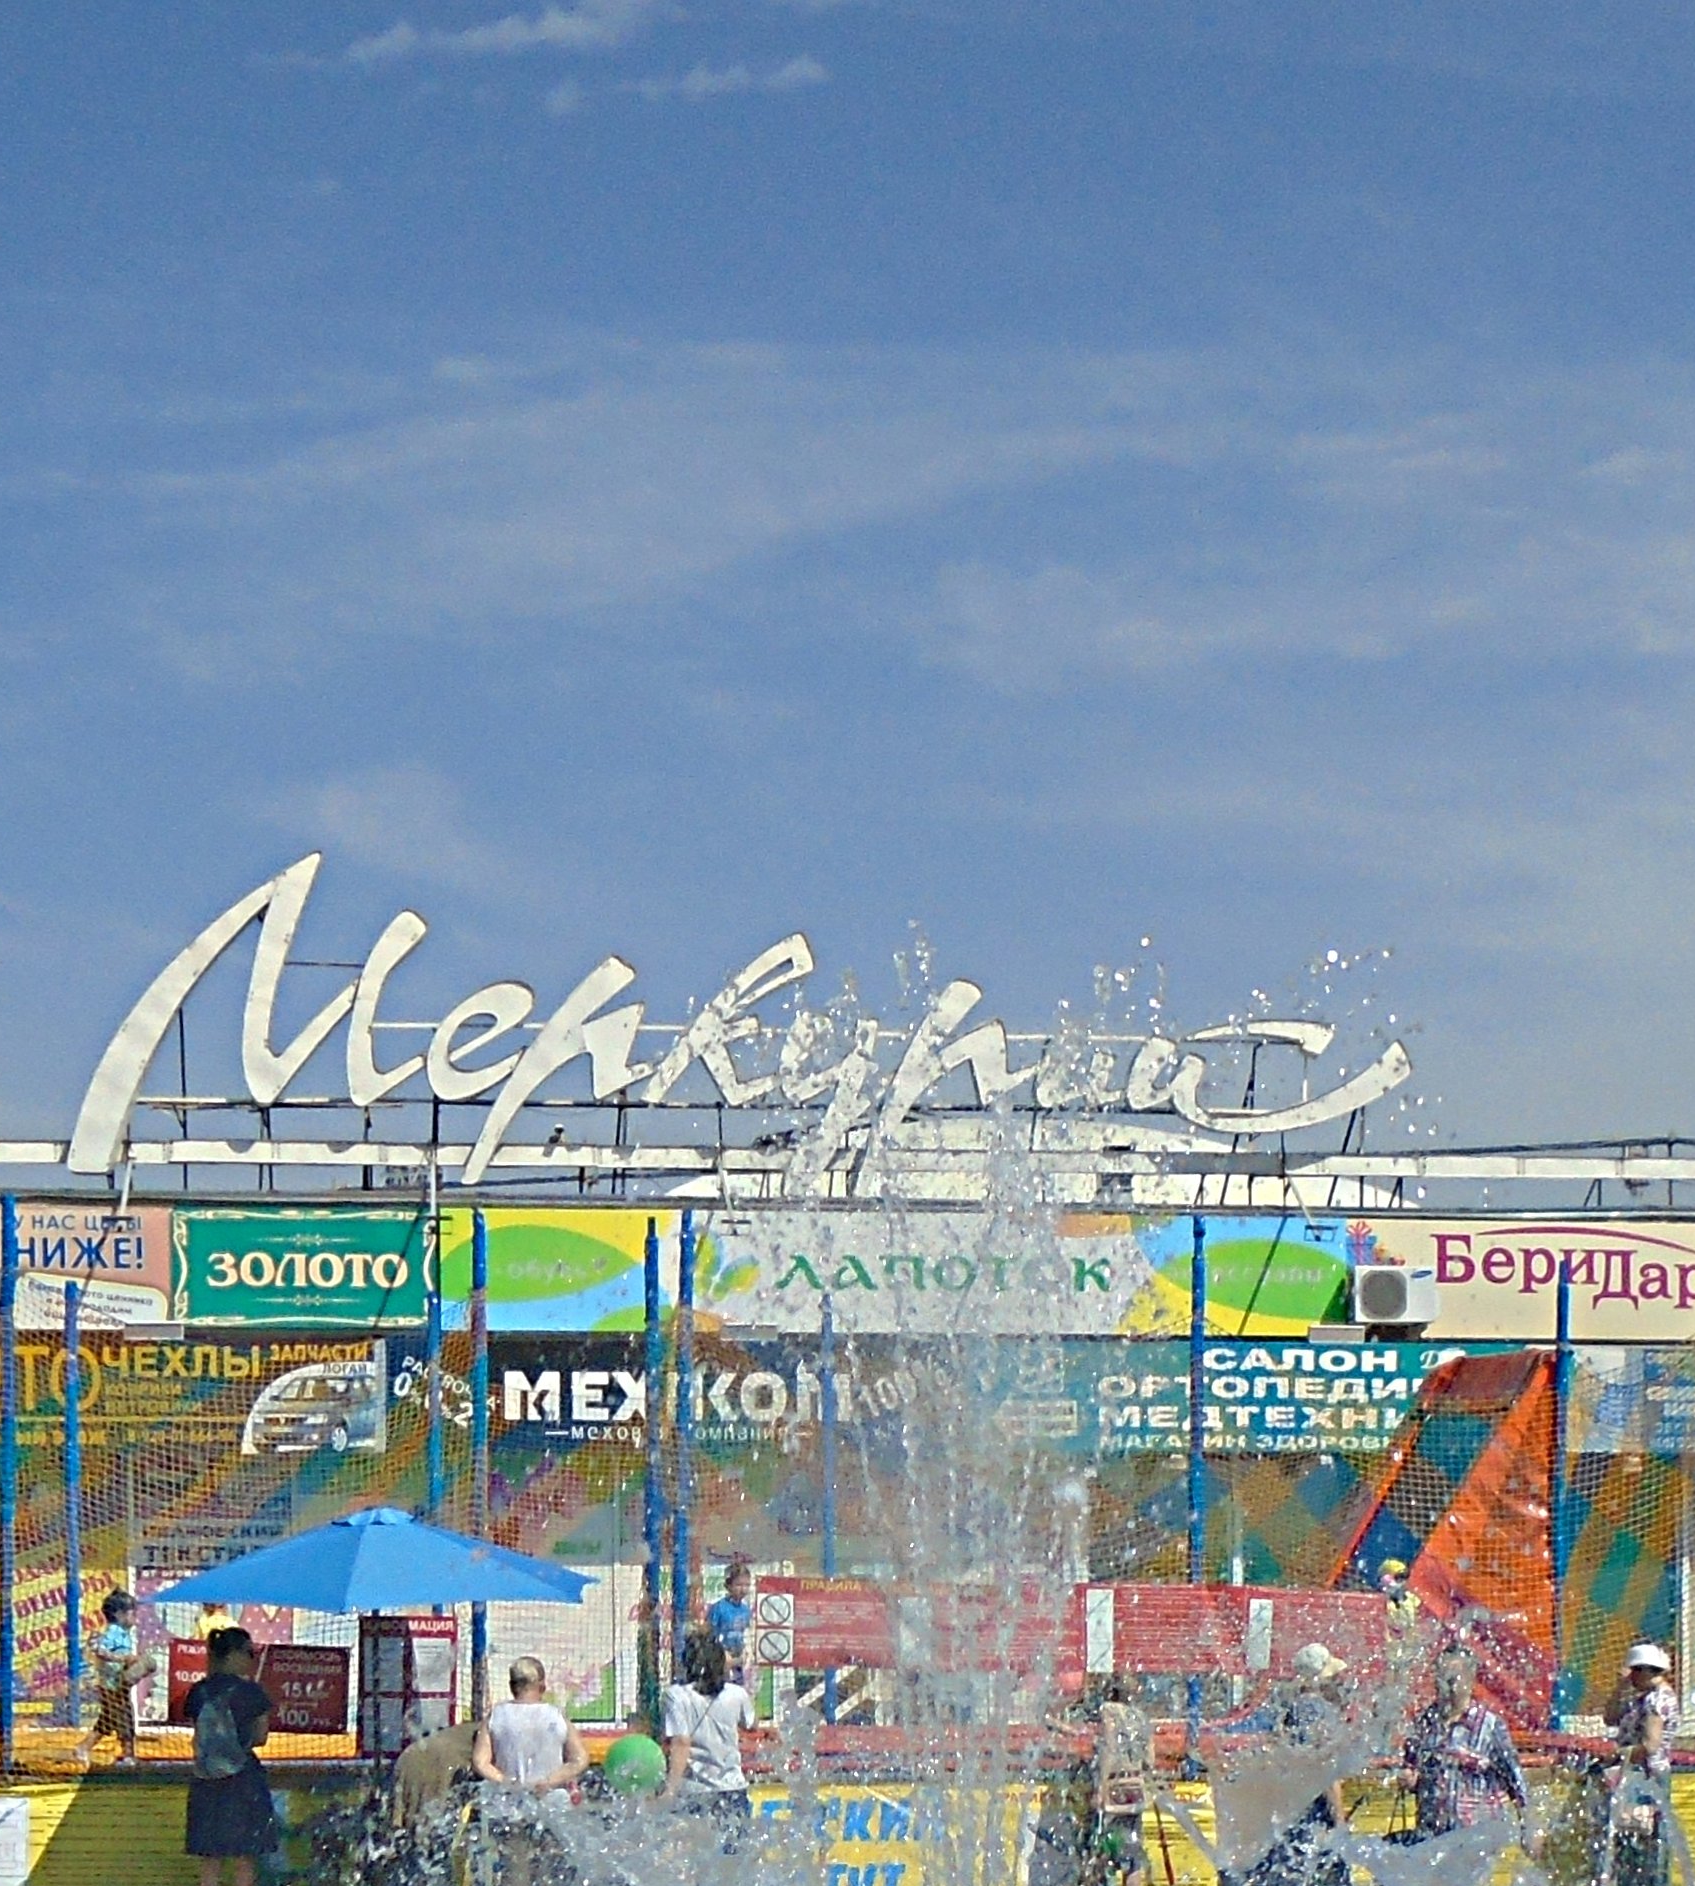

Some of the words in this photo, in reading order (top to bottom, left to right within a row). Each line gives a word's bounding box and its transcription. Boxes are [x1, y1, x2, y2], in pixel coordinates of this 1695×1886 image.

[32, 1214, 75, 1230] НАС
[84, 1215, 142, 1232] ЦЫ
[16, 1236, 144, 1270] НИЖЕ!
[206, 1251, 409, 1290] ЗОЛОТО
[102, 1345, 260, 1378] ЧЕХЛЫ
[269, 1342, 369, 1362] ЗАПЧАСТИ
[1202, 1348, 1399, 1373] САЛОН
[1099, 1404, 1406, 1432] МЕДТЕХНИ
[1099, 1434, 1247, 1450] МАГАИН
[142, 1545, 268, 1563] ТЕКСТИ
